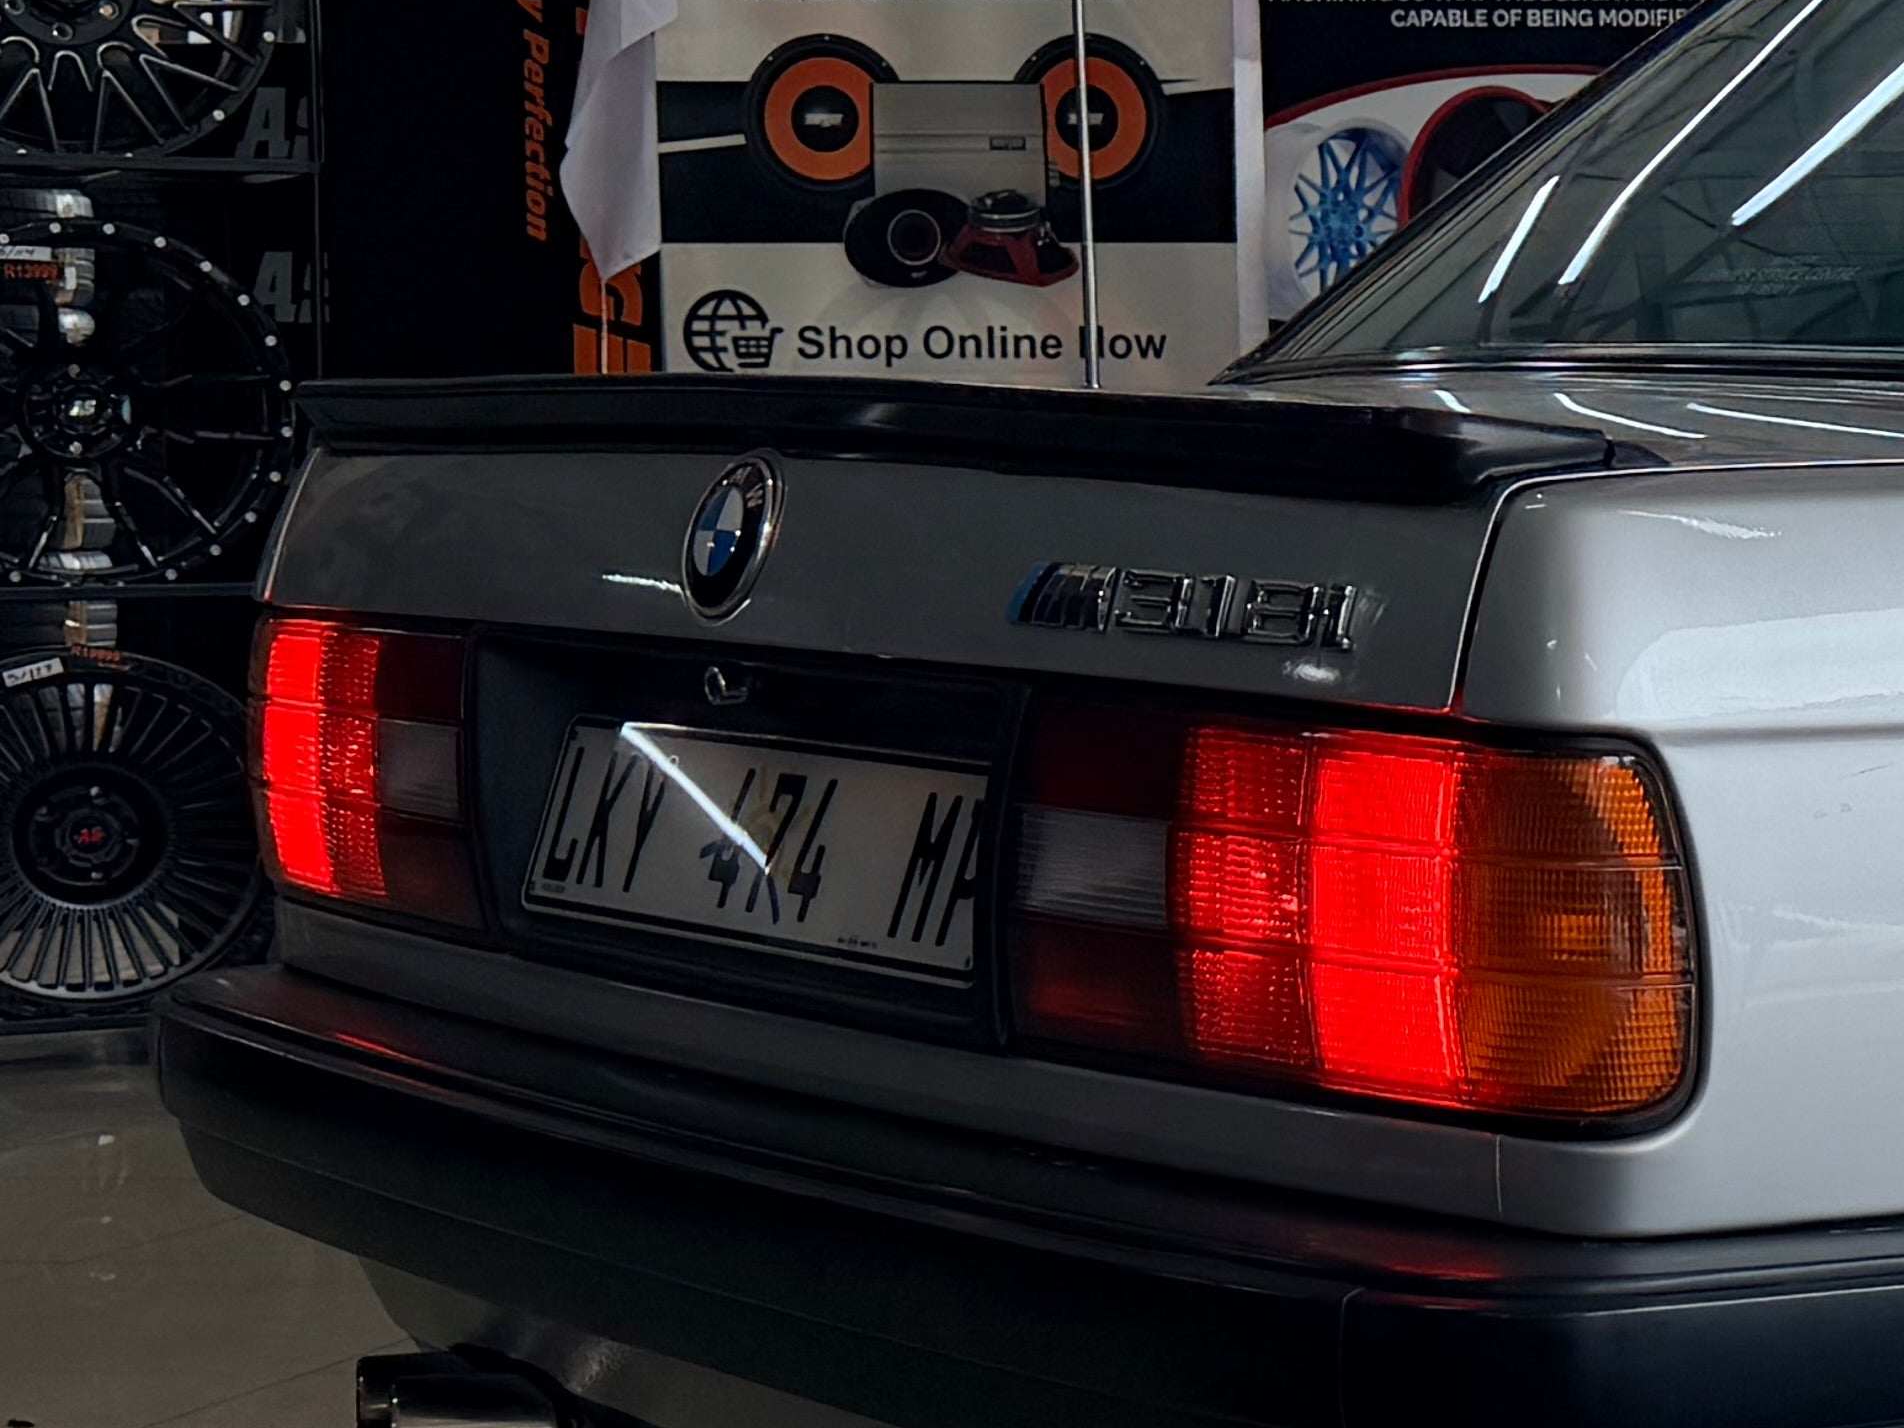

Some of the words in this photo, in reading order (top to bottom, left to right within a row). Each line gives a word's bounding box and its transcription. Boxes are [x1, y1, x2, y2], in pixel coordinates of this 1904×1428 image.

[1390, 9, 1487, 28] CAPABLE
[1493, 9, 1523, 28] OF
[1527, 9, 1593, 28] BEING
[1598, 8, 1687, 27] MODIFI
[521, 21, 557, 242] Perfection
[797, 326, 908, 368] Shop
[923, 326, 1063, 360] Online
[543, 746, 668, 893] LKY
